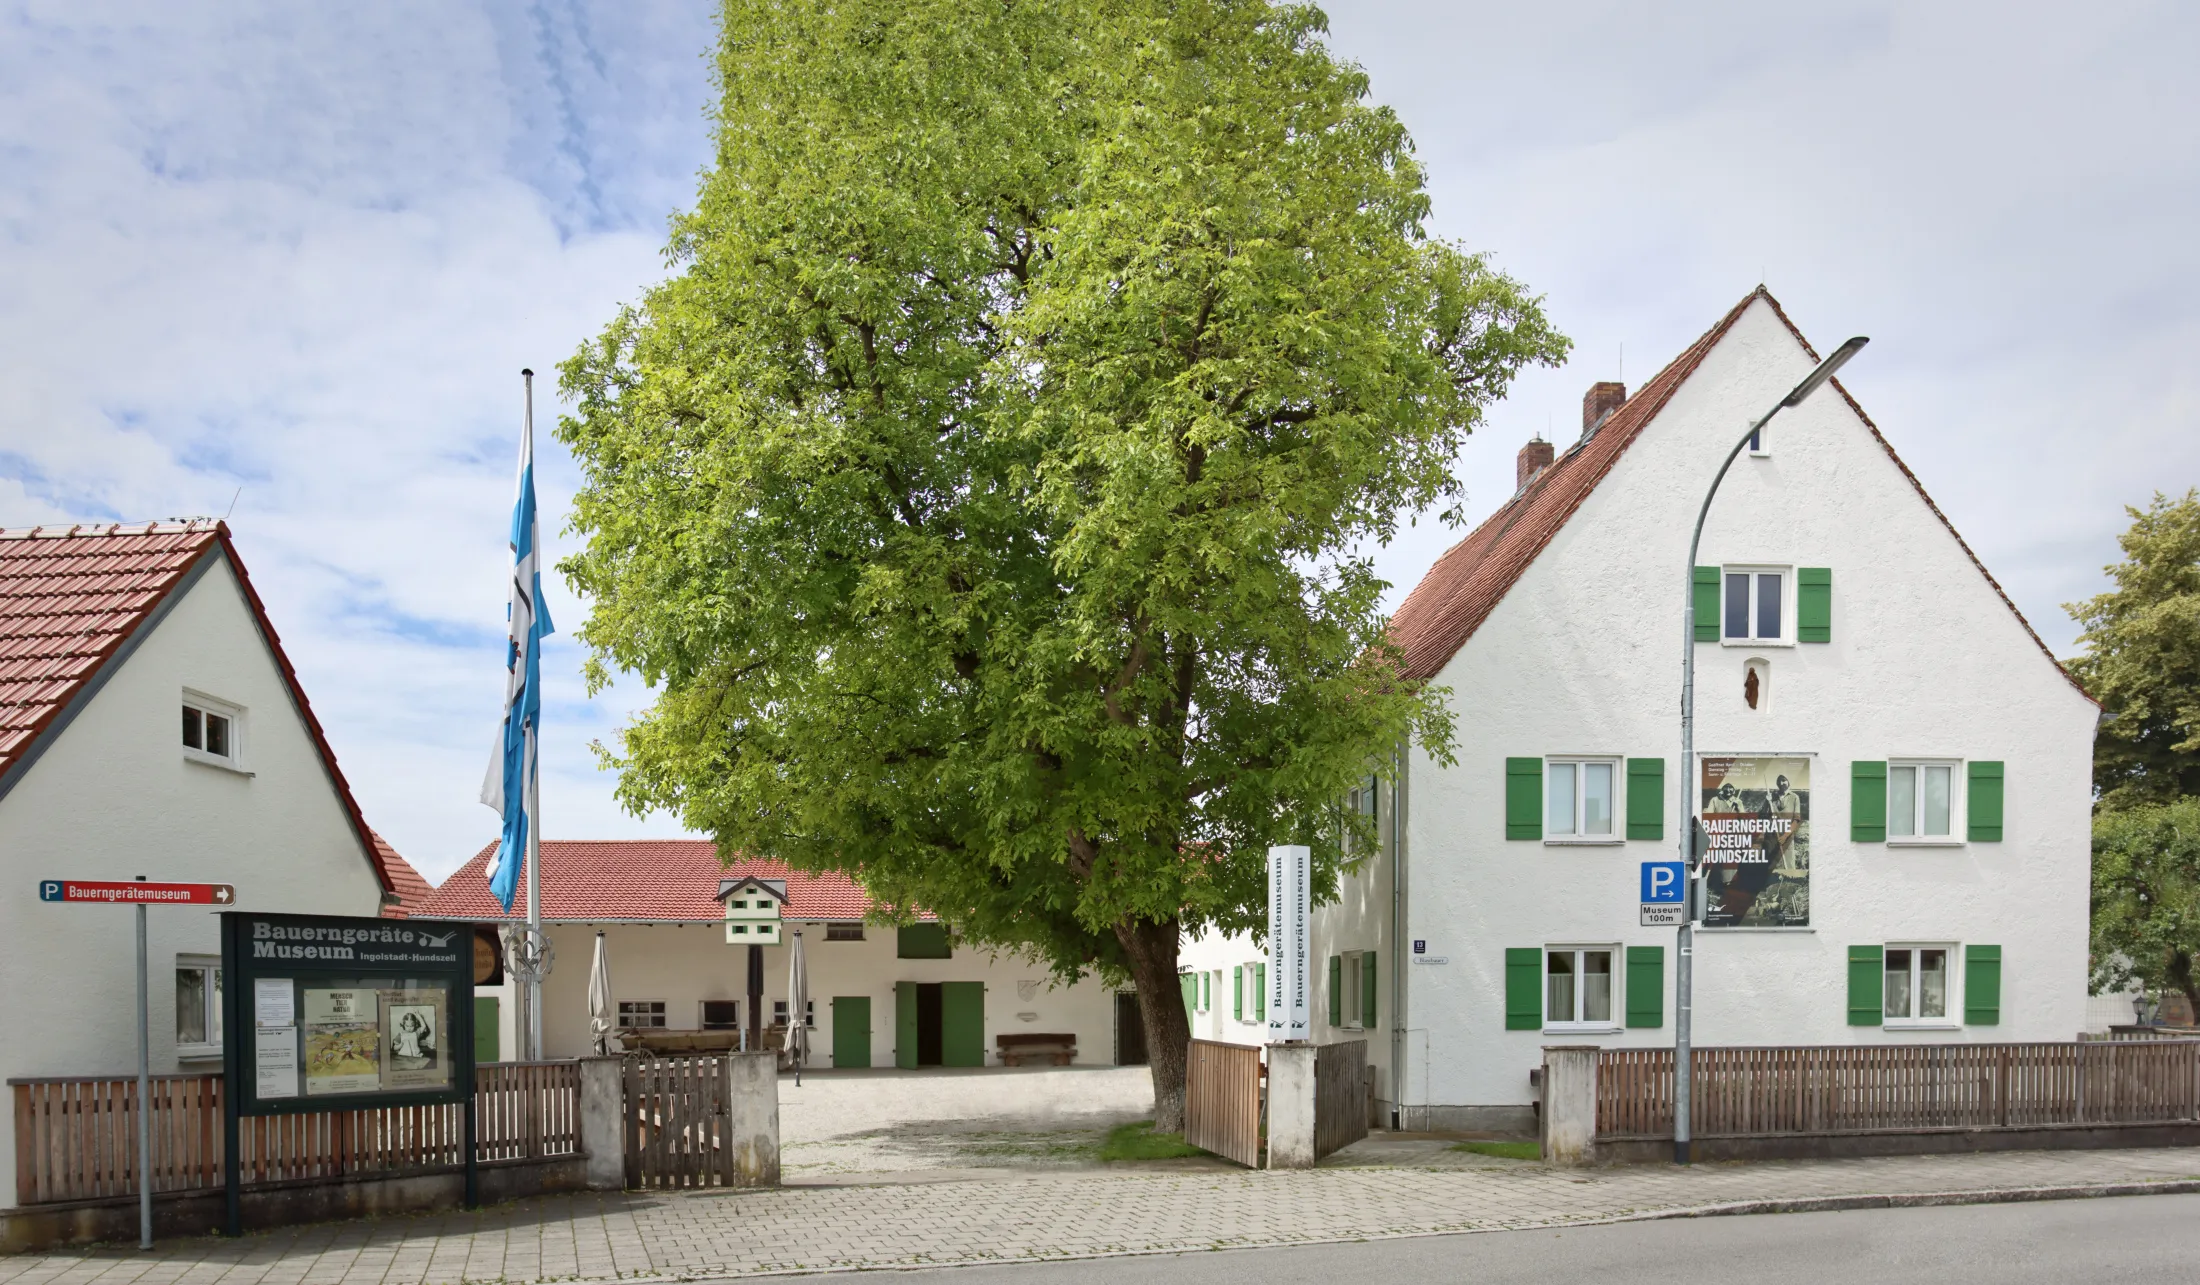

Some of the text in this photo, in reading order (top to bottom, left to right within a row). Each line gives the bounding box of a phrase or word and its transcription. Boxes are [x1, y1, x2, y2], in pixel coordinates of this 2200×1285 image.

[1702, 815, 1792, 833] BAUERNGERÄTE
[1702, 849, 1769, 864] HUNDSZELL
[1651, 866, 1675, 898] P
[45, 883, 191, 902] P Bauerngerätemuseum
[1643, 906, 1682, 914] Museum
[1649, 914, 1674, 922] 100m
[252, 921, 414, 945] Bauerngeräte
[1273, 857, 1283, 1008] Bauerngerätemuseum
[1295, 857, 1305, 1008] Bauerngerätemuseum
[253, 941, 456, 962] Museum Ingolstadt-Hundszell
